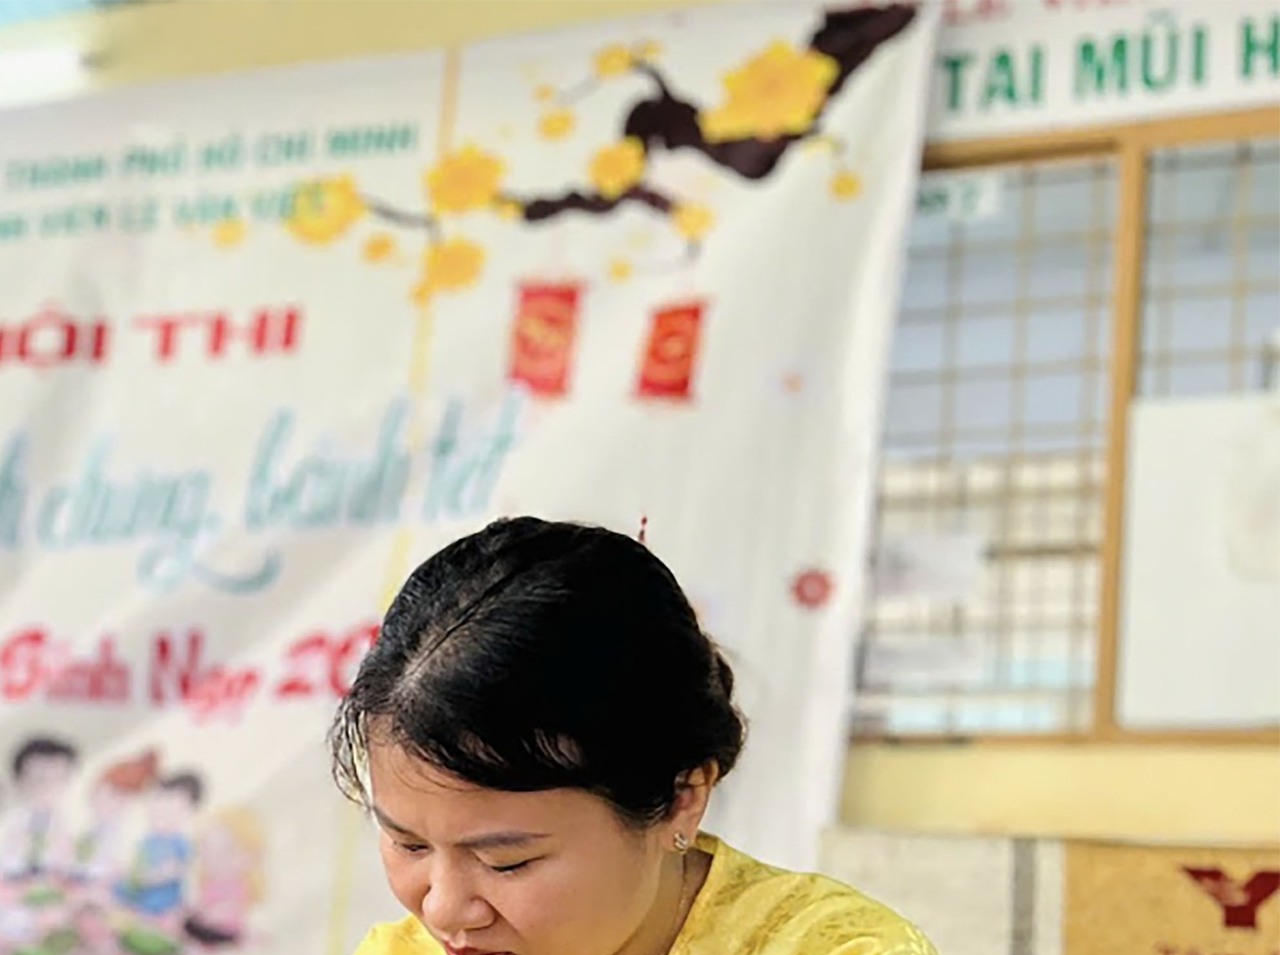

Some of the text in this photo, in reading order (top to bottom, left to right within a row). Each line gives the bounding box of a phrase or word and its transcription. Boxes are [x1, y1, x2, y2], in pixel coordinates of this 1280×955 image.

[940, 44, 1046, 111] TAI
[1075, 10, 1206, 97] MŨI
[327, 122, 418, 157] MINH
[131, 303, 302, 362] THI
[245, 400, 410, 532] bánh
